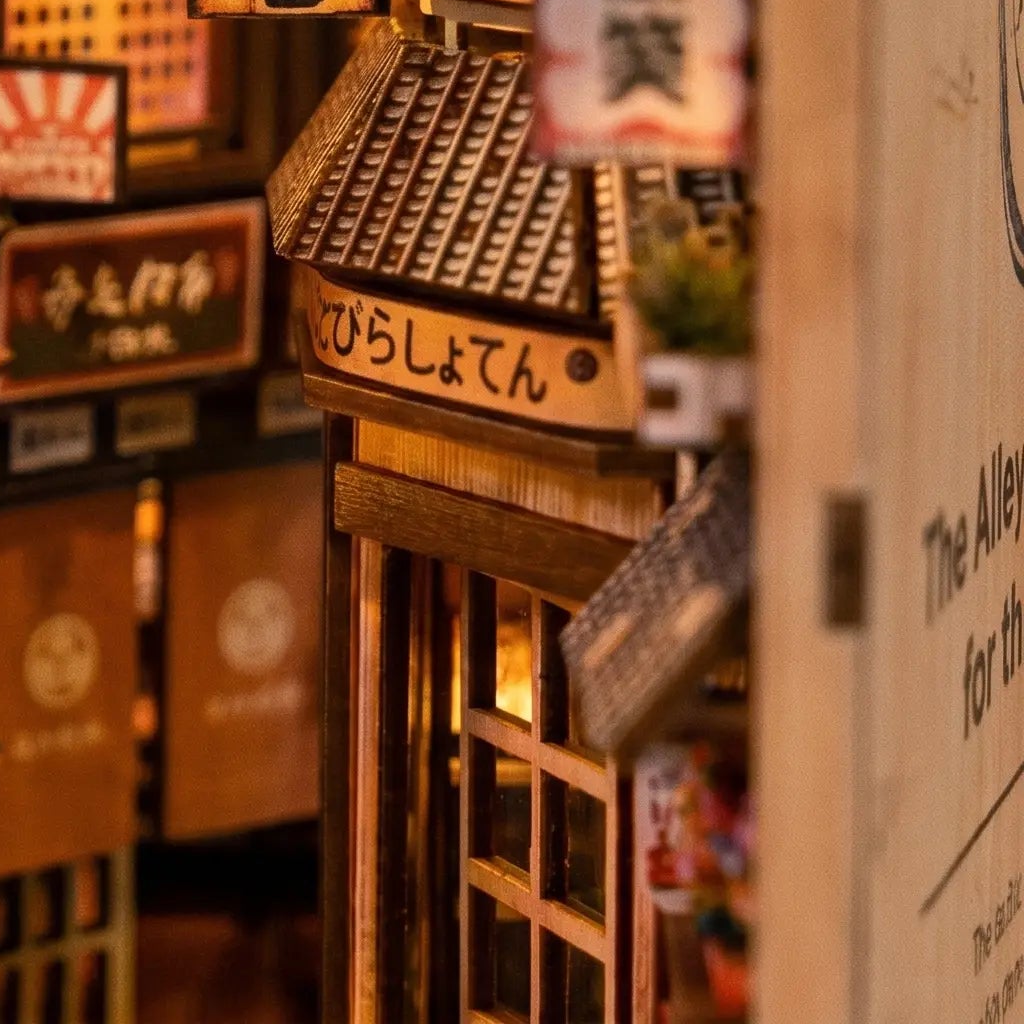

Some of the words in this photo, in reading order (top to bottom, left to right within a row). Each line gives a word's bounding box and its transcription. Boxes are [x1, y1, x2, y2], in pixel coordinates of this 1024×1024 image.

[922, 506, 969, 628] The
[973, 441, 1024, 572] Alley
[962, 632, 996, 741] for
